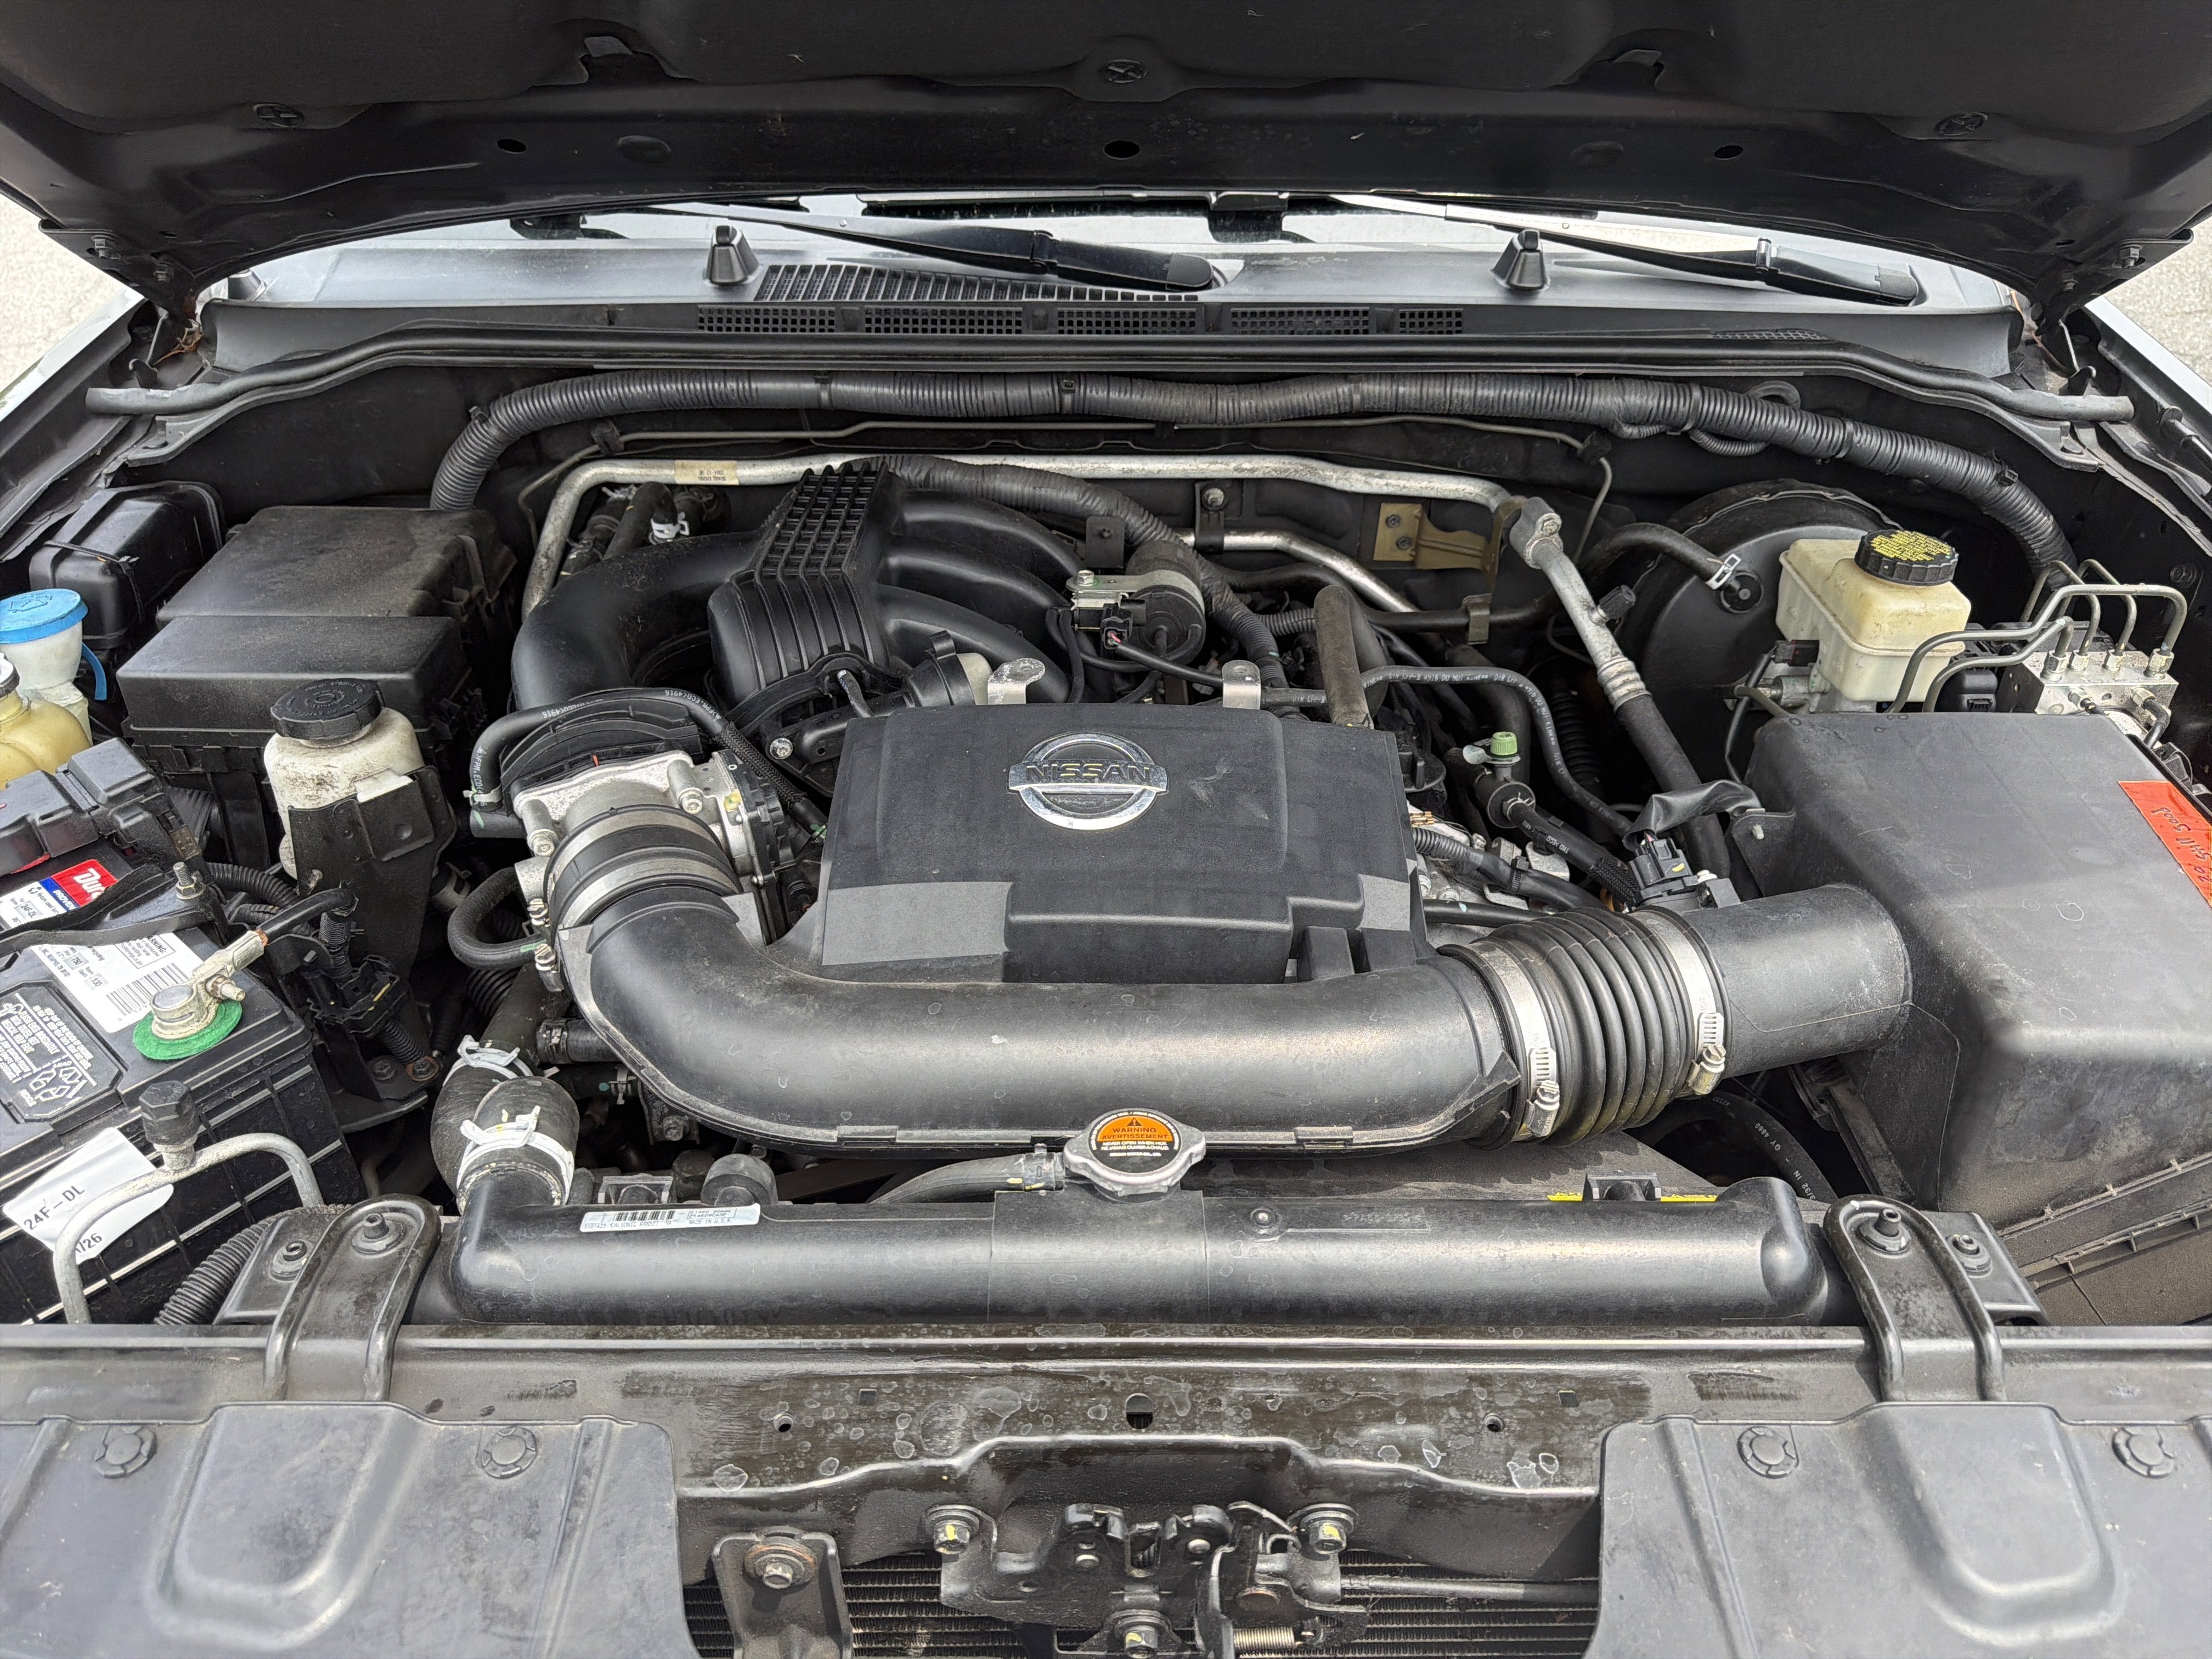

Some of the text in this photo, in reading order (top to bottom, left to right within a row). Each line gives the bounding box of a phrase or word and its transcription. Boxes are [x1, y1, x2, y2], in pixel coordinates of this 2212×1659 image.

[1026, 763, 1150, 780] NISSAN
[52, 889, 77, 910] PROVEN
[146, 935, 167, 953] ARNING:
[1754, 1123, 1770, 1138] 4860
[1770, 1140, 1781, 1151] GY
[1793, 1170, 1803, 1181] IN
